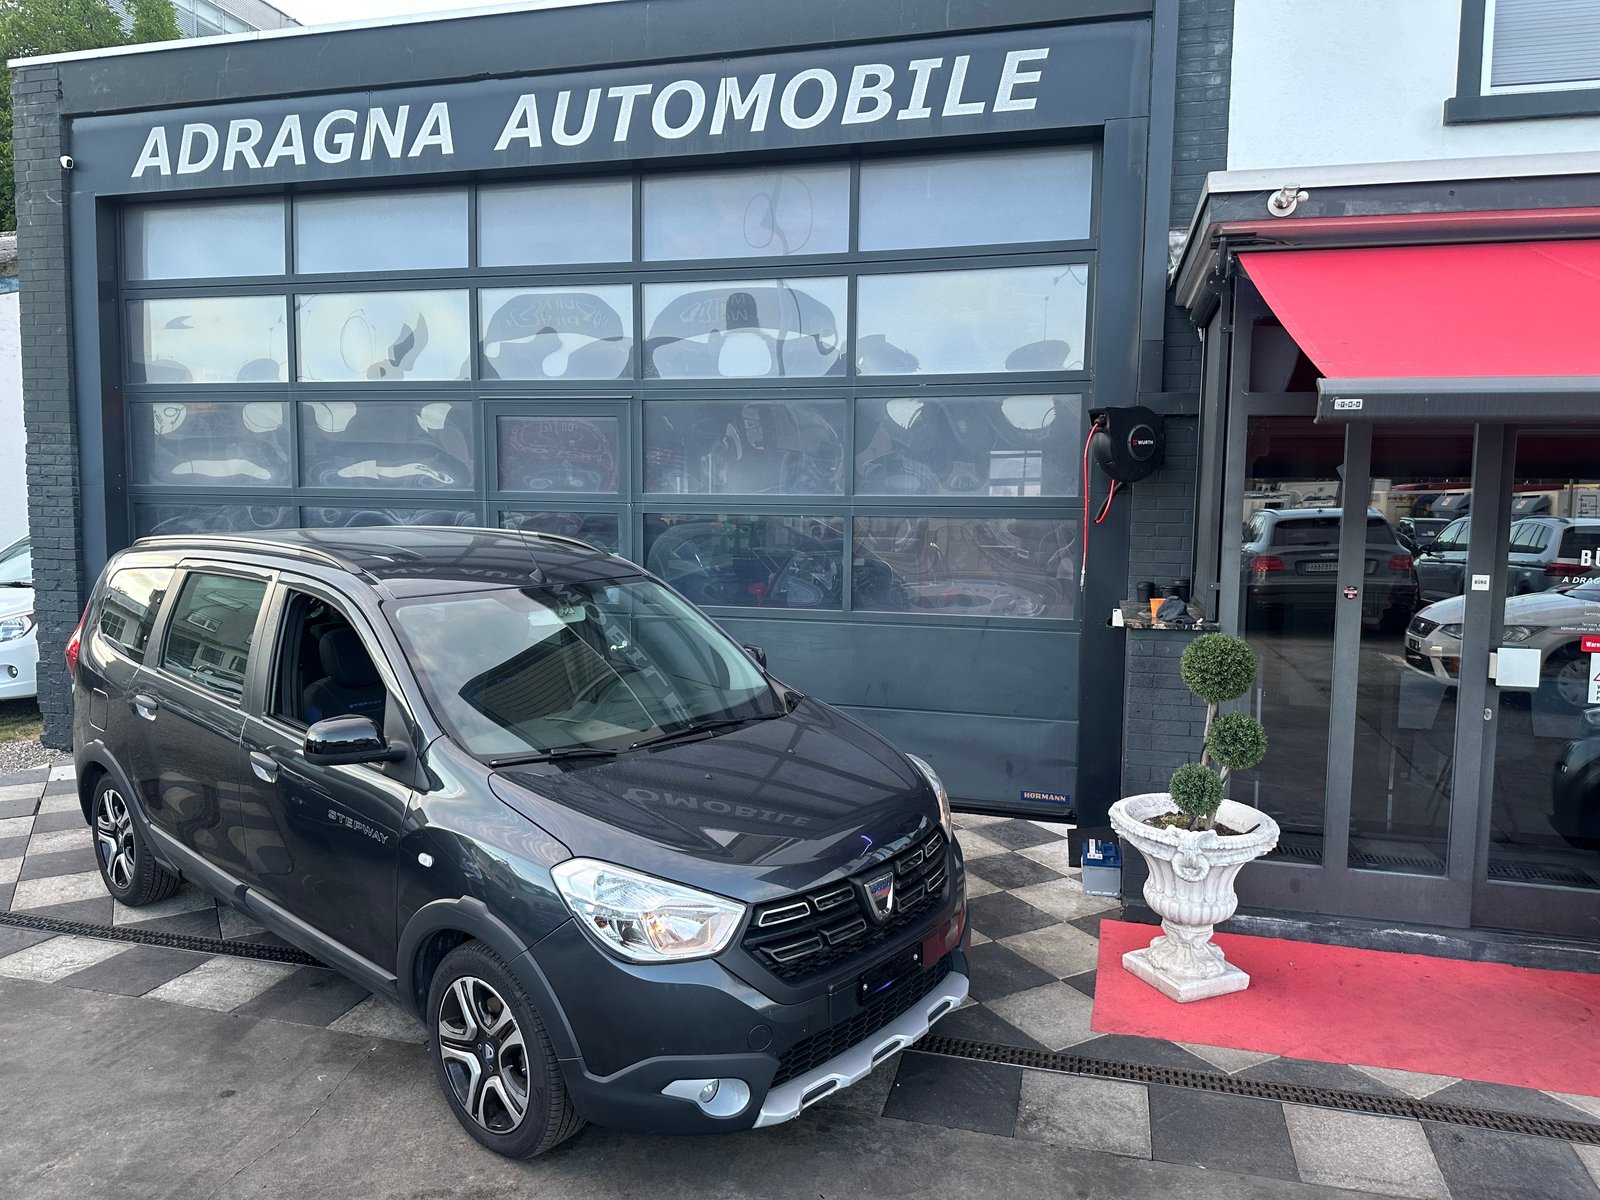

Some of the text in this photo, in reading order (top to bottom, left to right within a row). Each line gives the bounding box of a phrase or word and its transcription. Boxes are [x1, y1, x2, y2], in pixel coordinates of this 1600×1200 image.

[131, 47, 1050, 179] ADRAGNA AUTOMOBILE
[327, 809, 389, 844] STEPWAY
